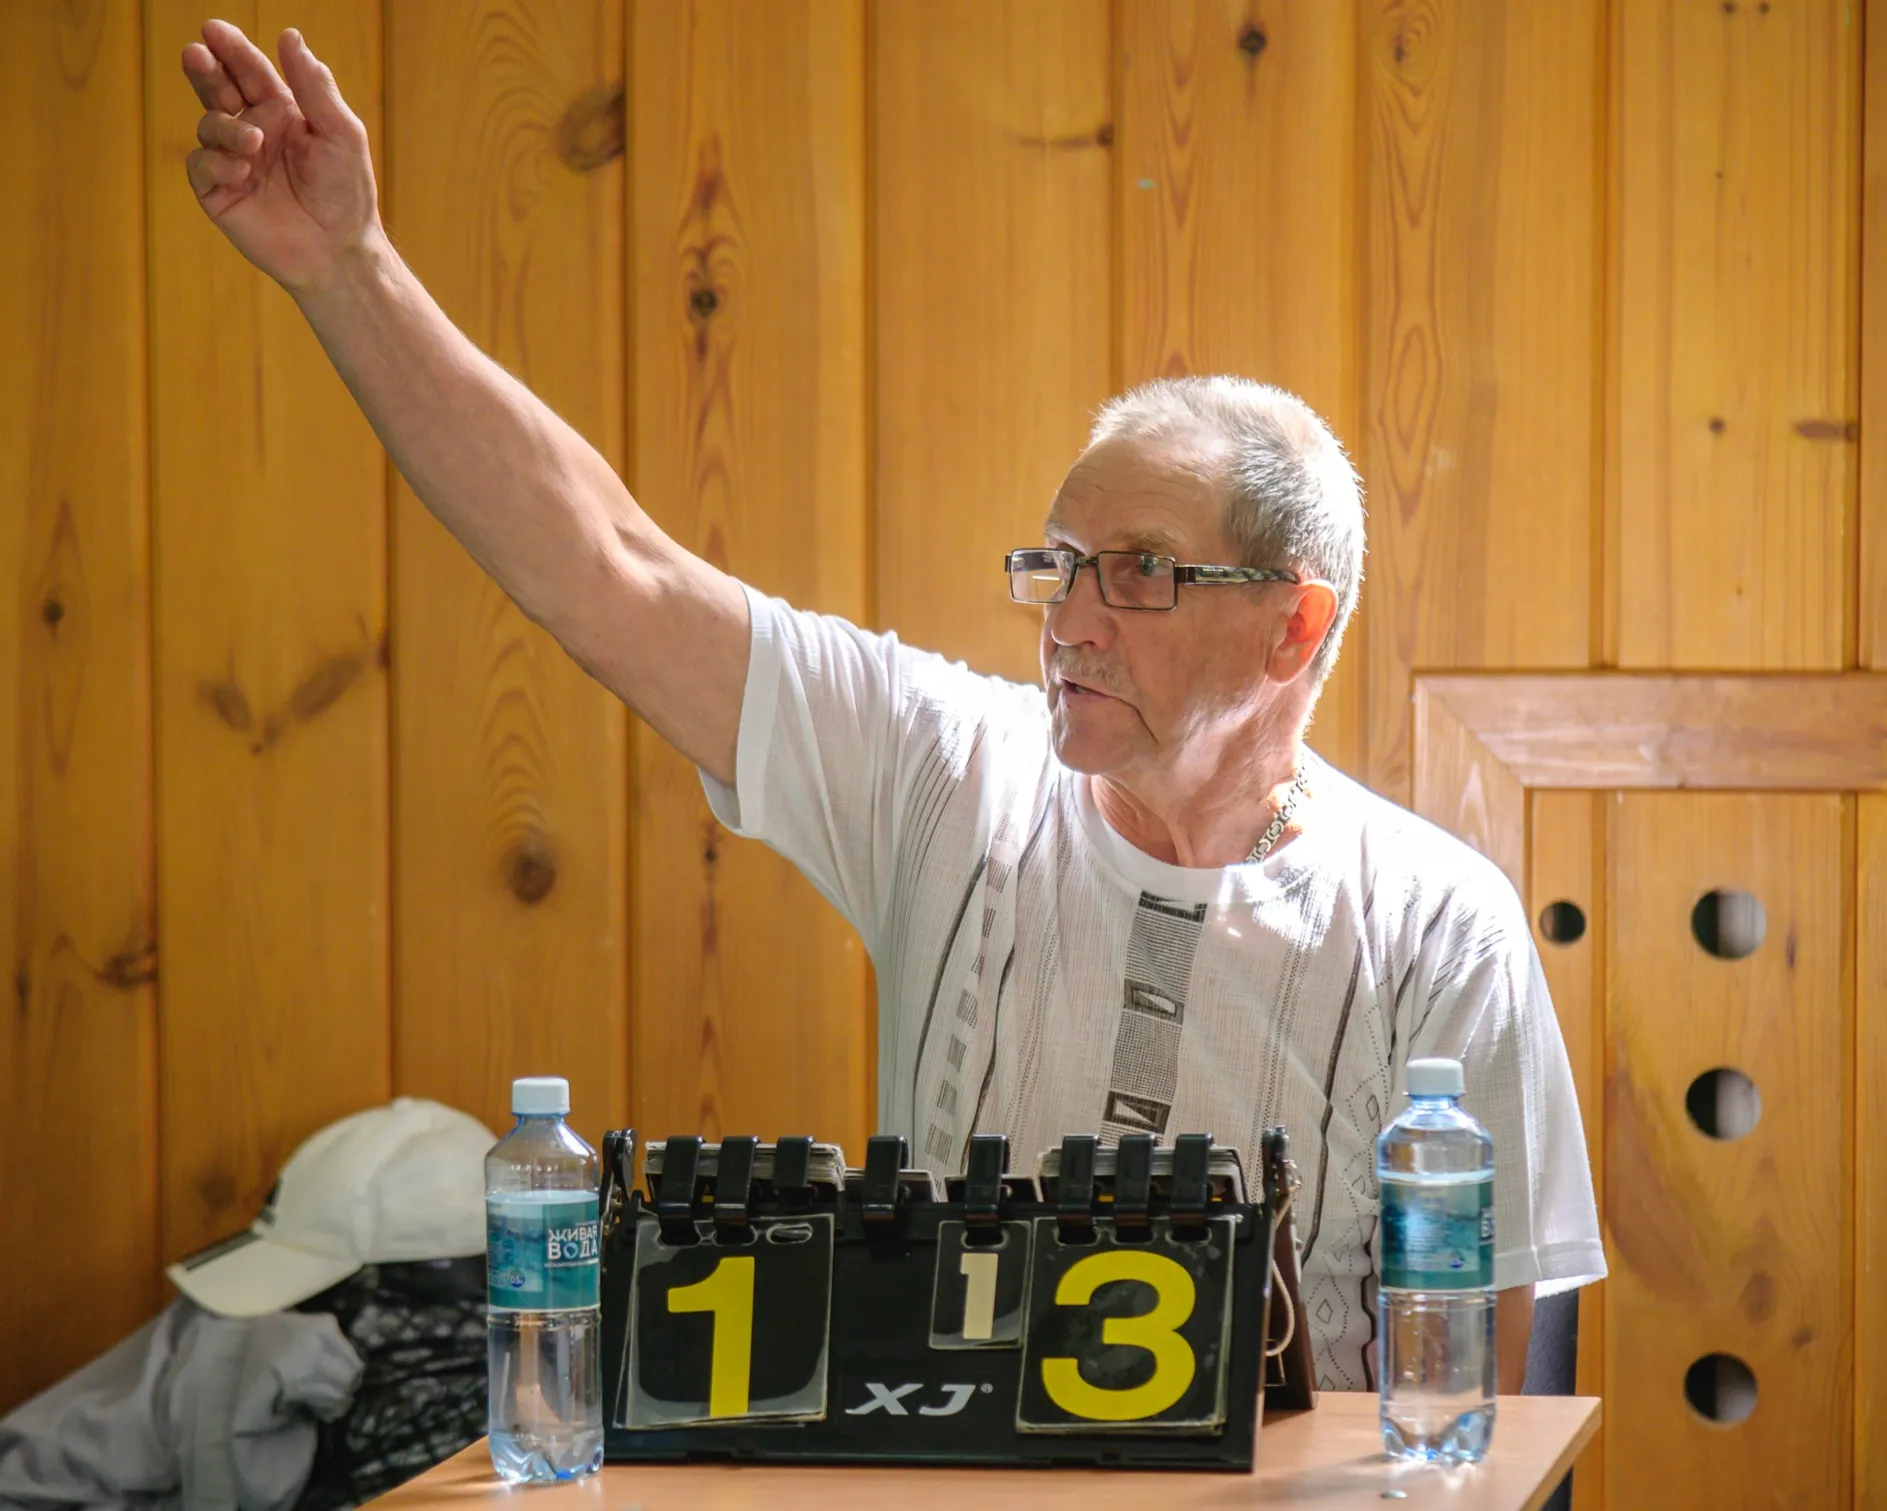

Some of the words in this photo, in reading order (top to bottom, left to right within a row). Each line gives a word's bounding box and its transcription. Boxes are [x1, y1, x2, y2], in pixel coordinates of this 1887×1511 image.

[548, 1225, 598, 1241] ЖИВАЯ
[548, 1240, 598, 1259] ВОДА
[667, 1256, 755, 1419] 1
[960, 1252, 999, 1340] 1
[1041, 1250, 1196, 1421] 3
